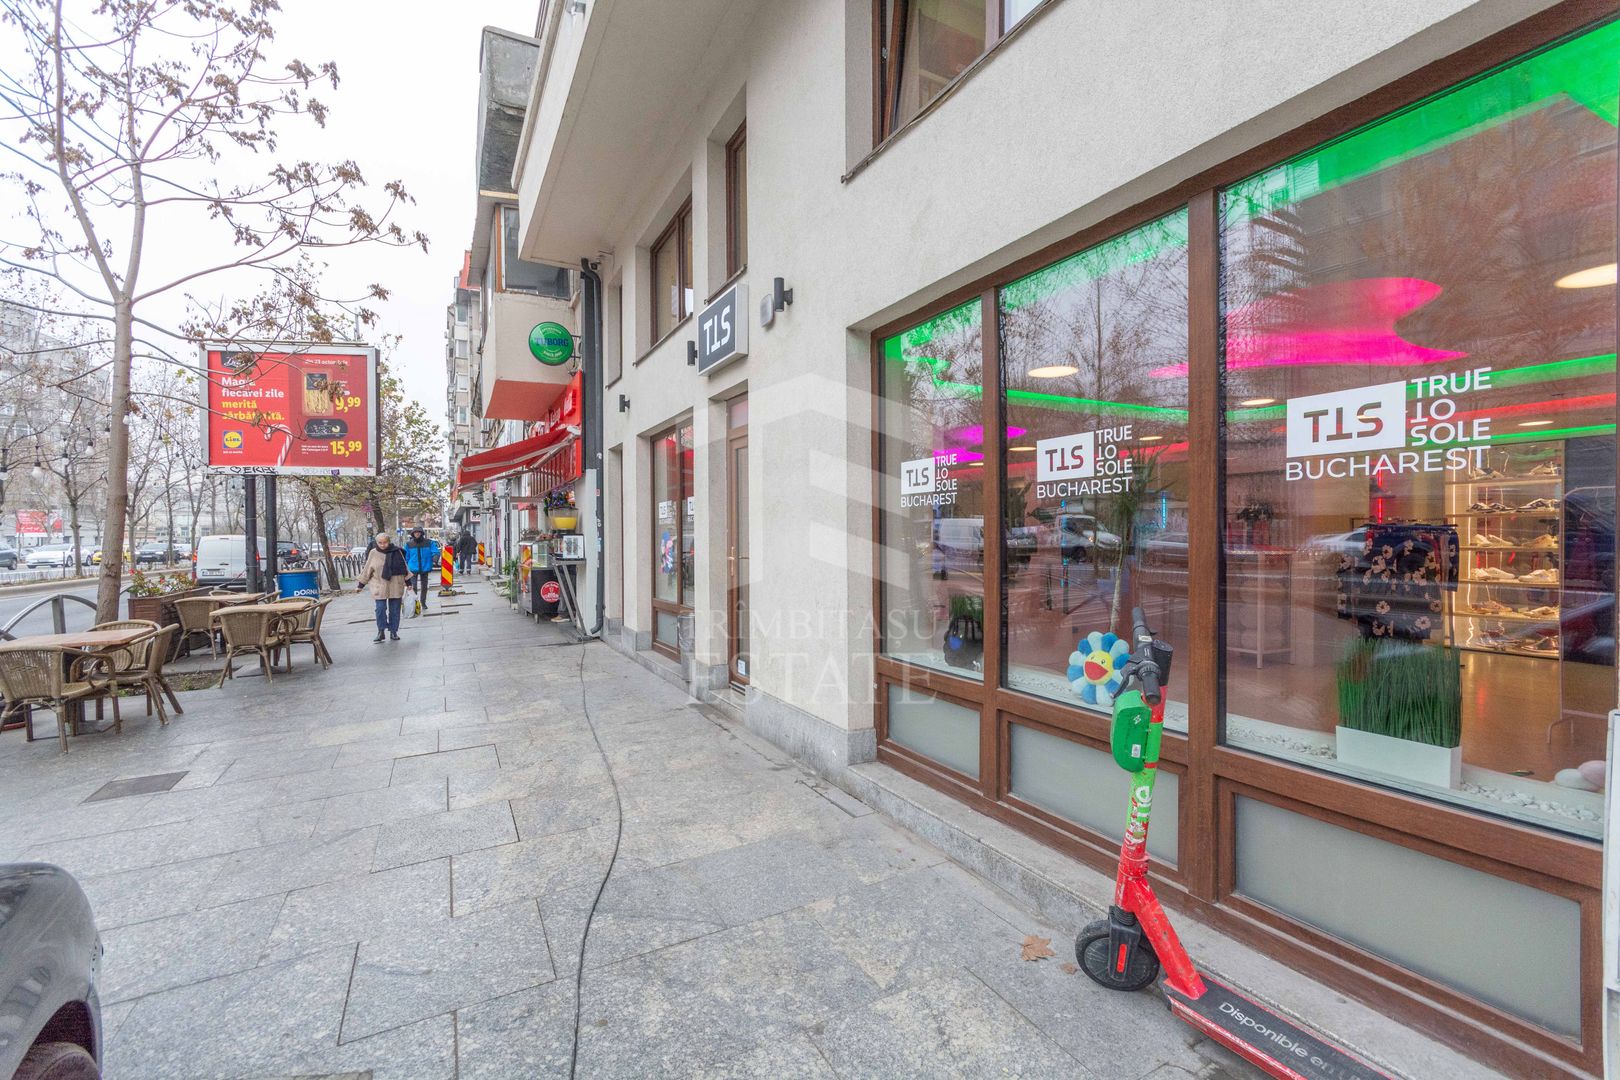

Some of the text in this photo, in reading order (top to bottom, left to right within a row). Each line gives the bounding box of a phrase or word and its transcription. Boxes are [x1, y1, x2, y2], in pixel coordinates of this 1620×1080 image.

[535, 337, 569, 347] TUBORG
[221, 377, 256, 388] Maga
[1411, 366, 1492, 399] TRUE
[265, 388, 285, 398] zile
[335, 397, 361, 413] 9,99
[1096, 425, 1132, 444] TRUE
[1410, 417, 1491, 446] SOLE
[330, 440, 362, 457] 15,99
[936, 453, 958, 467] TRUE
[1096, 458, 1132, 476] SOLE
[1286, 445, 1492, 481] BUCHAREST
[936, 479, 958, 492] SOLE
[1037, 476, 1133, 499] BUCHAREST
[901, 492, 958, 508] BUCHAREST
[1218, 1001, 1308, 1058] Disponible
